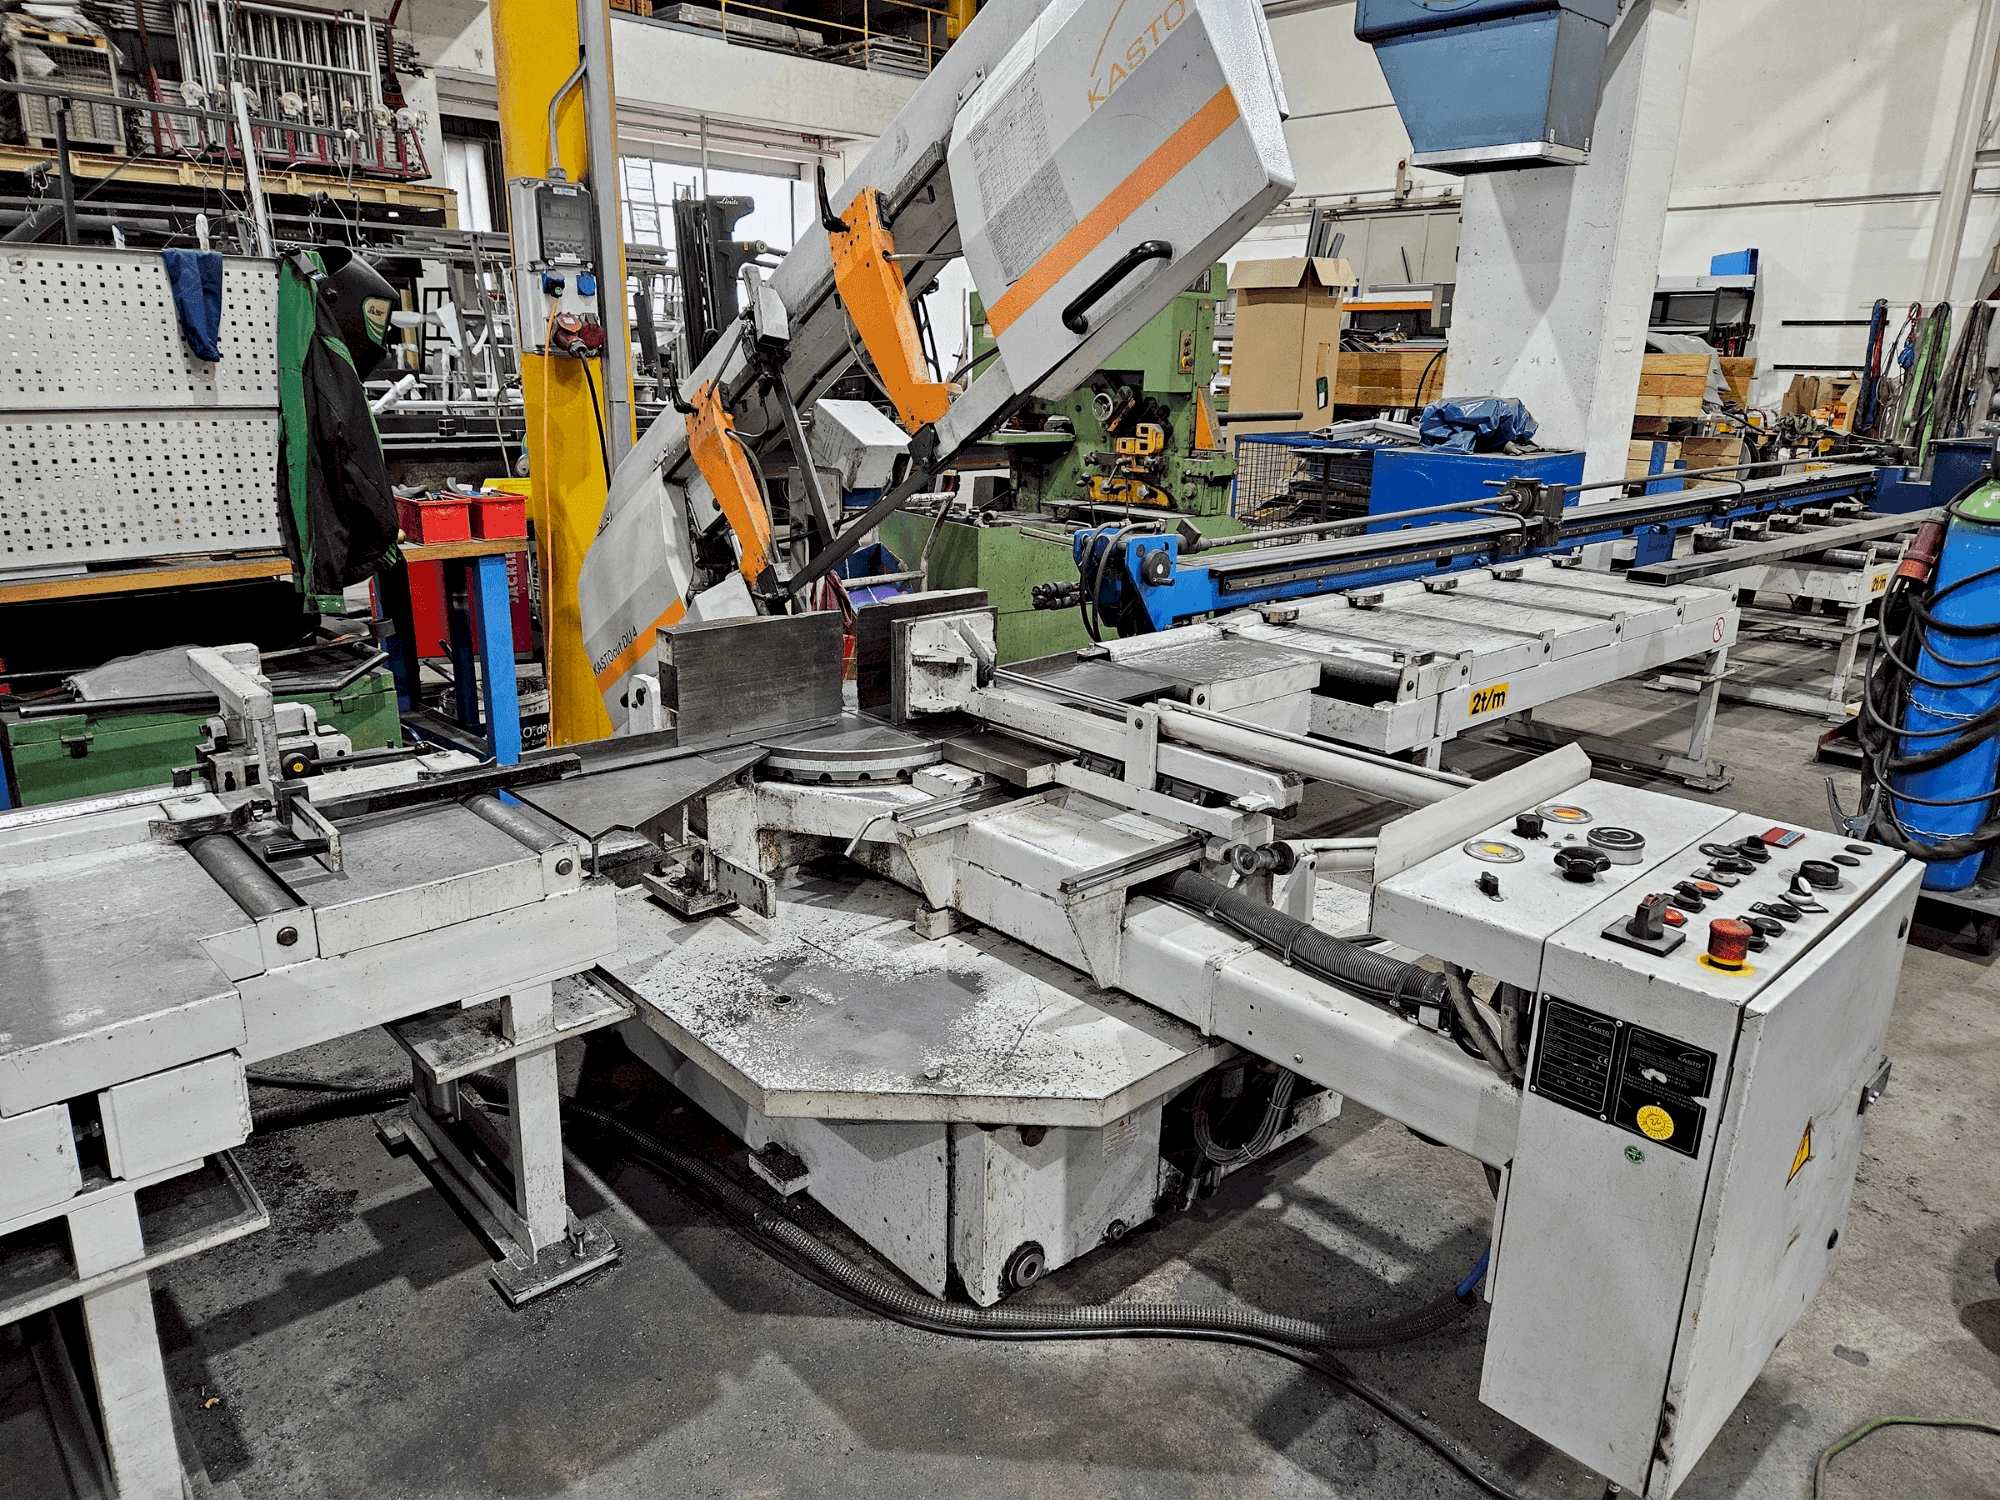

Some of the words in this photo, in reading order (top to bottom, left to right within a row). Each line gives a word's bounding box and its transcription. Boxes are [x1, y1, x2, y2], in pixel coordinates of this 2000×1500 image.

[1087, 0, 1185, 112] KASTO
[717, 196, 738, 205] Linde
[592, 641, 623, 677] KASTOcut
[621, 629, 632, 649] DU
[632, 624, 638, 638] 4
[1471, 688, 1506, 715] 2t/m
[1589, 1024, 1610, 1036] KASTO
[1677, 1055, 1701, 1069] KASTO
